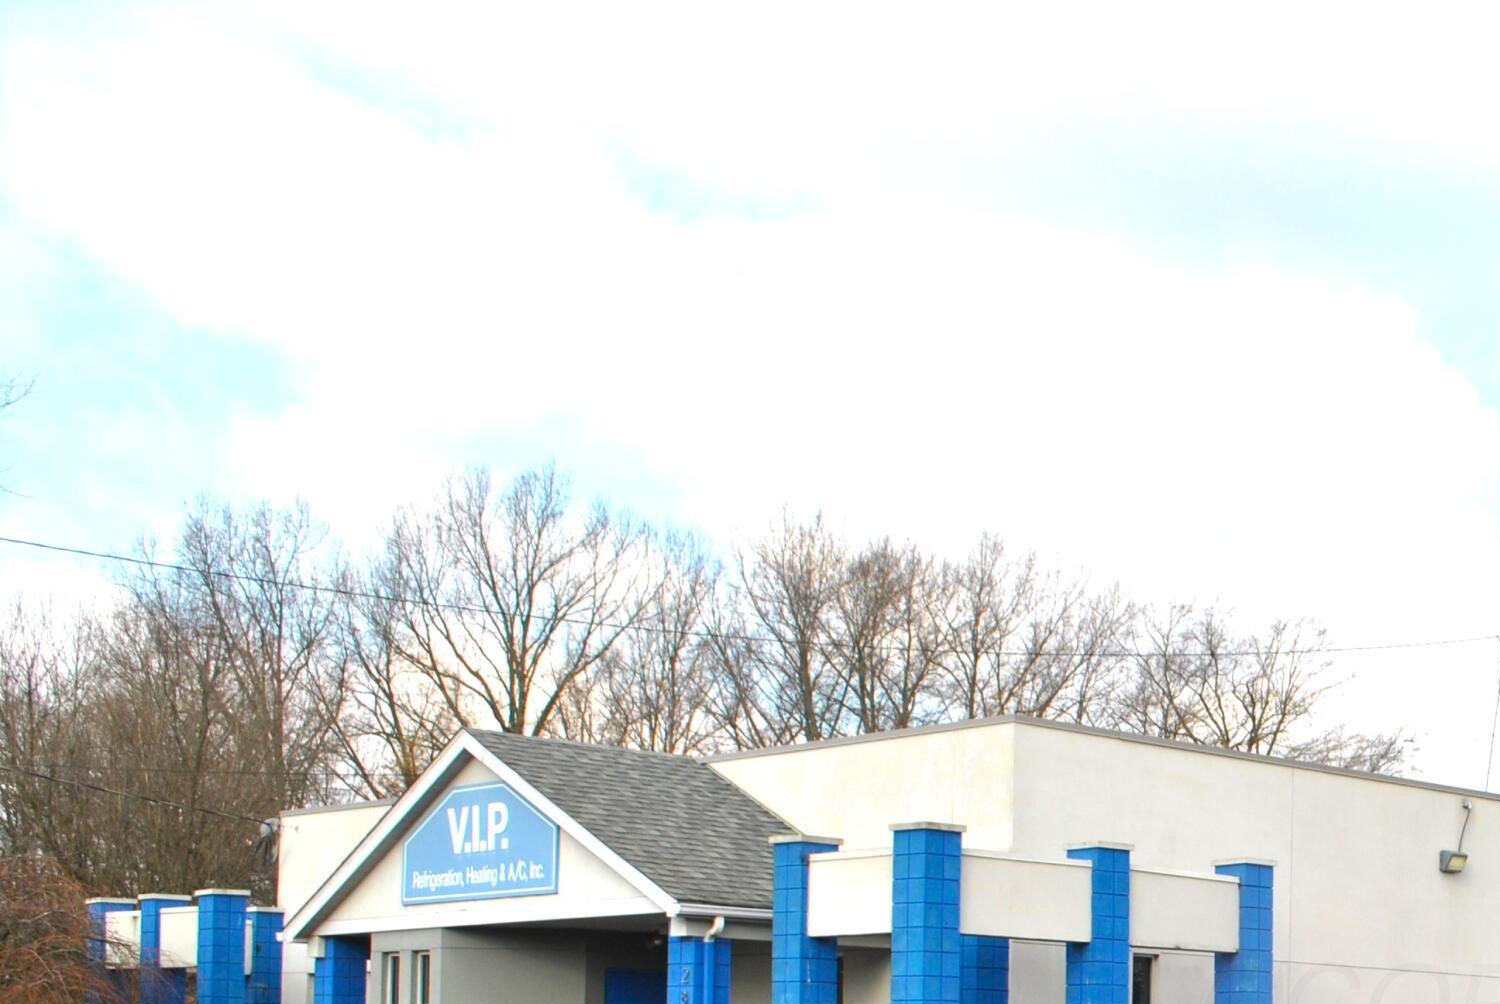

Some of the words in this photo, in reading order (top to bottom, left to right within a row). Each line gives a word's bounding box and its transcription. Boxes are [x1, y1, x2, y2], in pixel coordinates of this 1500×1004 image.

[447, 802, 509, 855] V.I.P.
[412, 868, 464, 891] Refrigeration,
[466, 865, 498, 886] Heating
[500, 863, 506, 881] &
[508, 859, 528, 882] A/C,
[529, 861, 545, 879] Inc.
